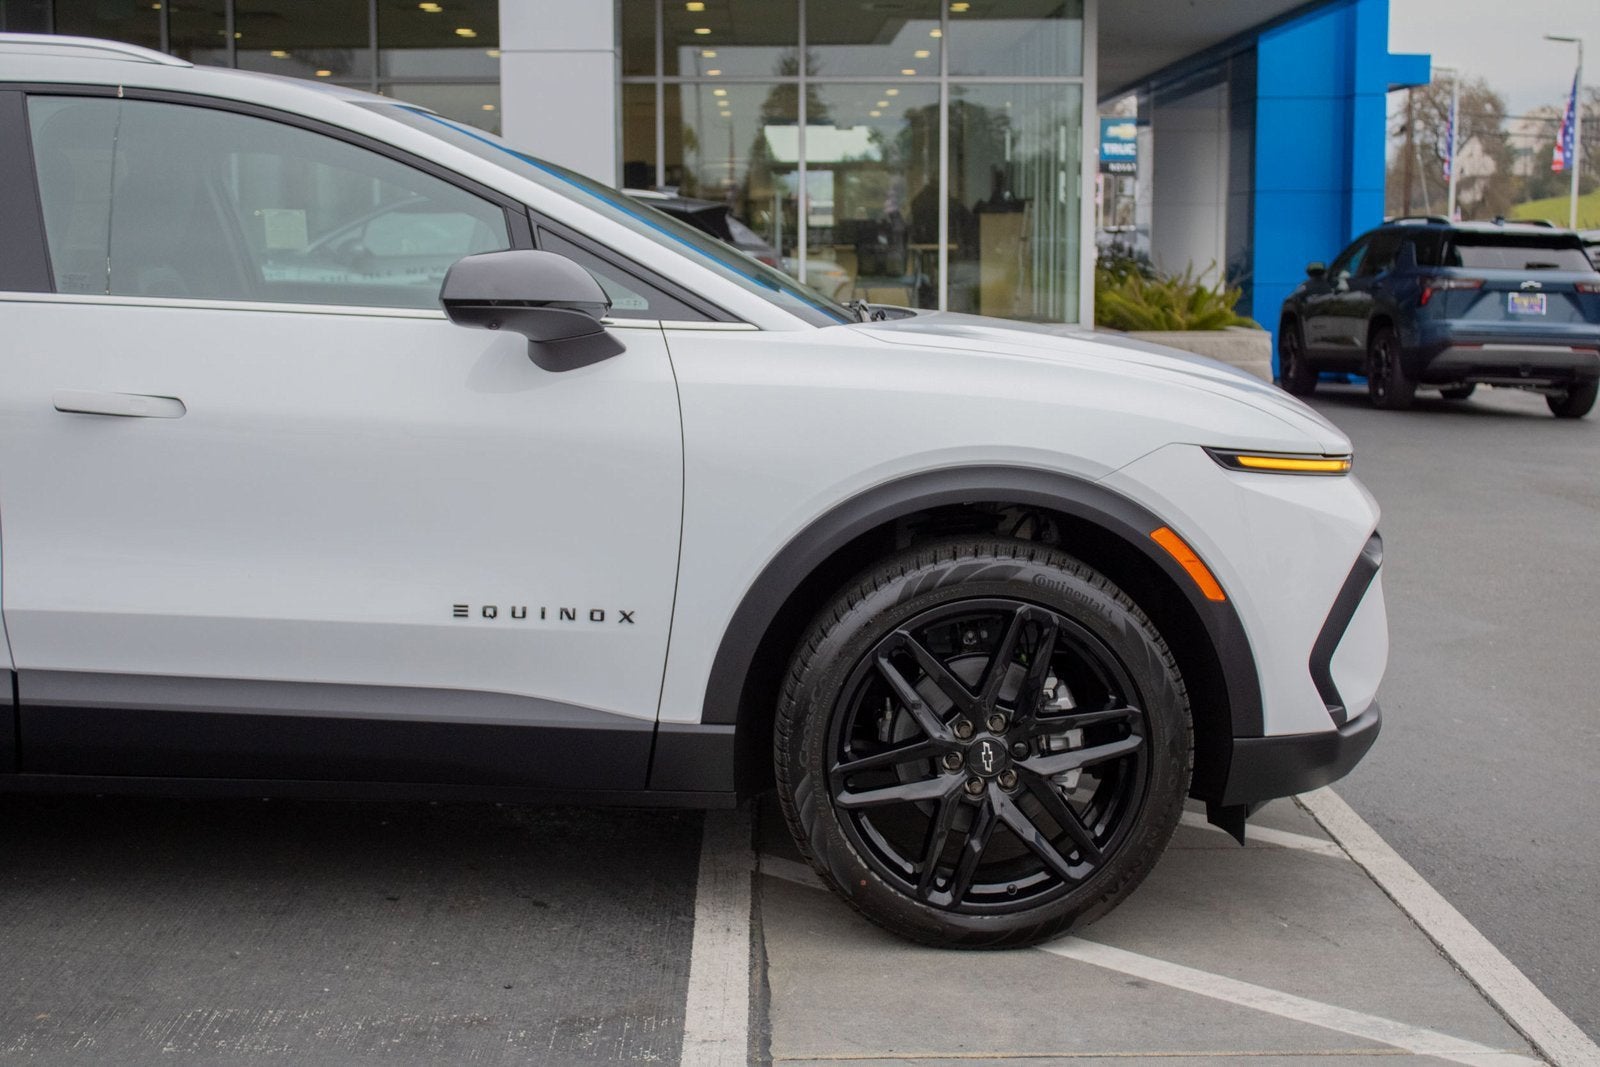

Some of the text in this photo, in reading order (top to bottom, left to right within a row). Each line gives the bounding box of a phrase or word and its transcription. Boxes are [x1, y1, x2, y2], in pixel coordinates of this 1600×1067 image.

[1102, 143, 1137, 156] TRUC
[1032, 573, 1106, 611] Continental
[453, 604, 635, 625] EQUINOX
